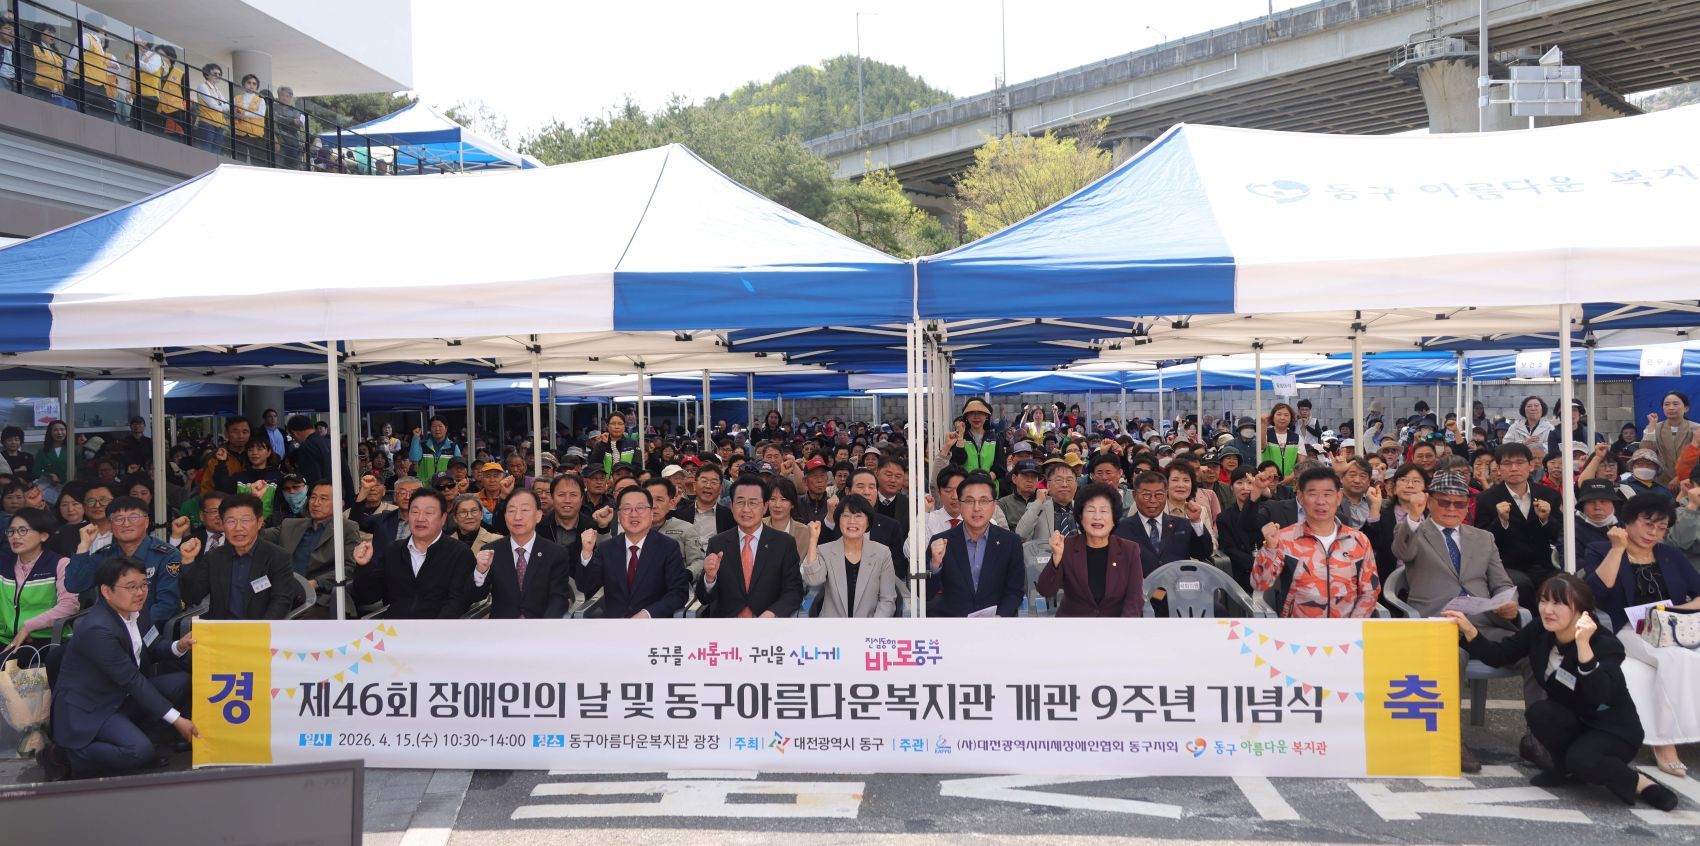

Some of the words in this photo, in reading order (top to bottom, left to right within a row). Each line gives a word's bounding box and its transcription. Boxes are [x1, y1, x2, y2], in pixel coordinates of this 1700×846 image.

[1325, 184, 1400, 201] 동구
[1420, 175, 1584, 201] 아름다운
[648, 646, 683, 666] 동구를
[688, 642, 742, 666] 새롭게,
[749, 646, 785, 665] 구민을
[790, 645, 840, 665] 신나게
[865, 638, 896, 649] 진심동행
[208, 672, 254, 724] 경
[299, 682, 417, 718] 제46회
[429, 682, 566, 718] 장애인의
[577, 683, 611, 718] 날
[621, 683, 654, 719] 및
[665, 683, 995, 720] 동구아름다운복지관
[1006, 684, 1080, 721] 개관
[1092, 685, 1195, 722] 9주년
[1207, 684, 1323, 723] 기념식
[1383, 675, 1445, 732] 축
[303, 733, 328, 746] 일시
[339, 733, 374, 746] 2026.
[379, 733, 390, 746] 4.
[396, 733, 437, 748] 15.(수)
[444, 734, 525, 747] 10:30~14:00
[536, 734, 561, 747] 장소
[569, 734, 689, 749] 동구아름다운복지관
[694, 735, 720, 749] 광장
[735, 737, 758, 750] 주최
[795, 737, 854, 750] 대전광역시
[860, 738, 884, 751] 동구
[899, 739, 924, 752] 주관
[1129, 741, 1178, 752] 동구지회
[1215, 741, 1236, 756] 동구
[1241, 740, 1288, 756] 아름다운
[1292, 741, 1327, 755] 복지관
